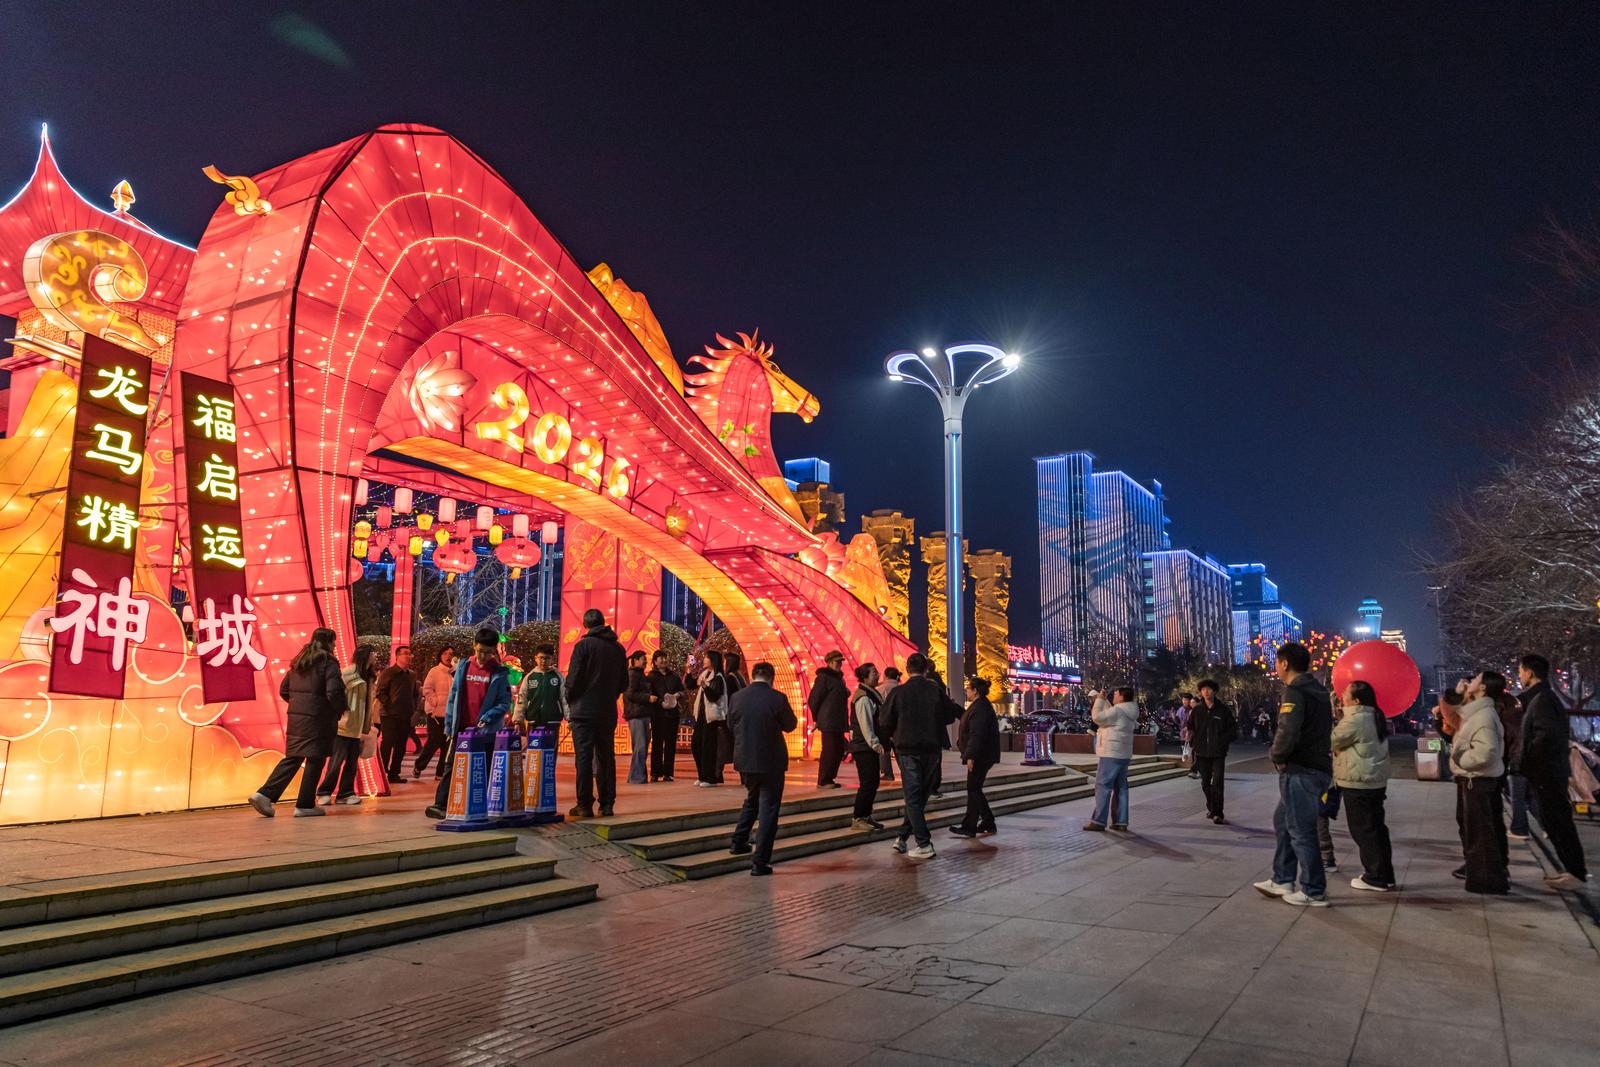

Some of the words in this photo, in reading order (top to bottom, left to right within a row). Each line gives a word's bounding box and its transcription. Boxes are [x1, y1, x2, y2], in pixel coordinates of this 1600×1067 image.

[50, 366, 149, 671] 龙马精神
[193, 394, 267, 671] 福启运城
[475, 382, 630, 498] 2026
